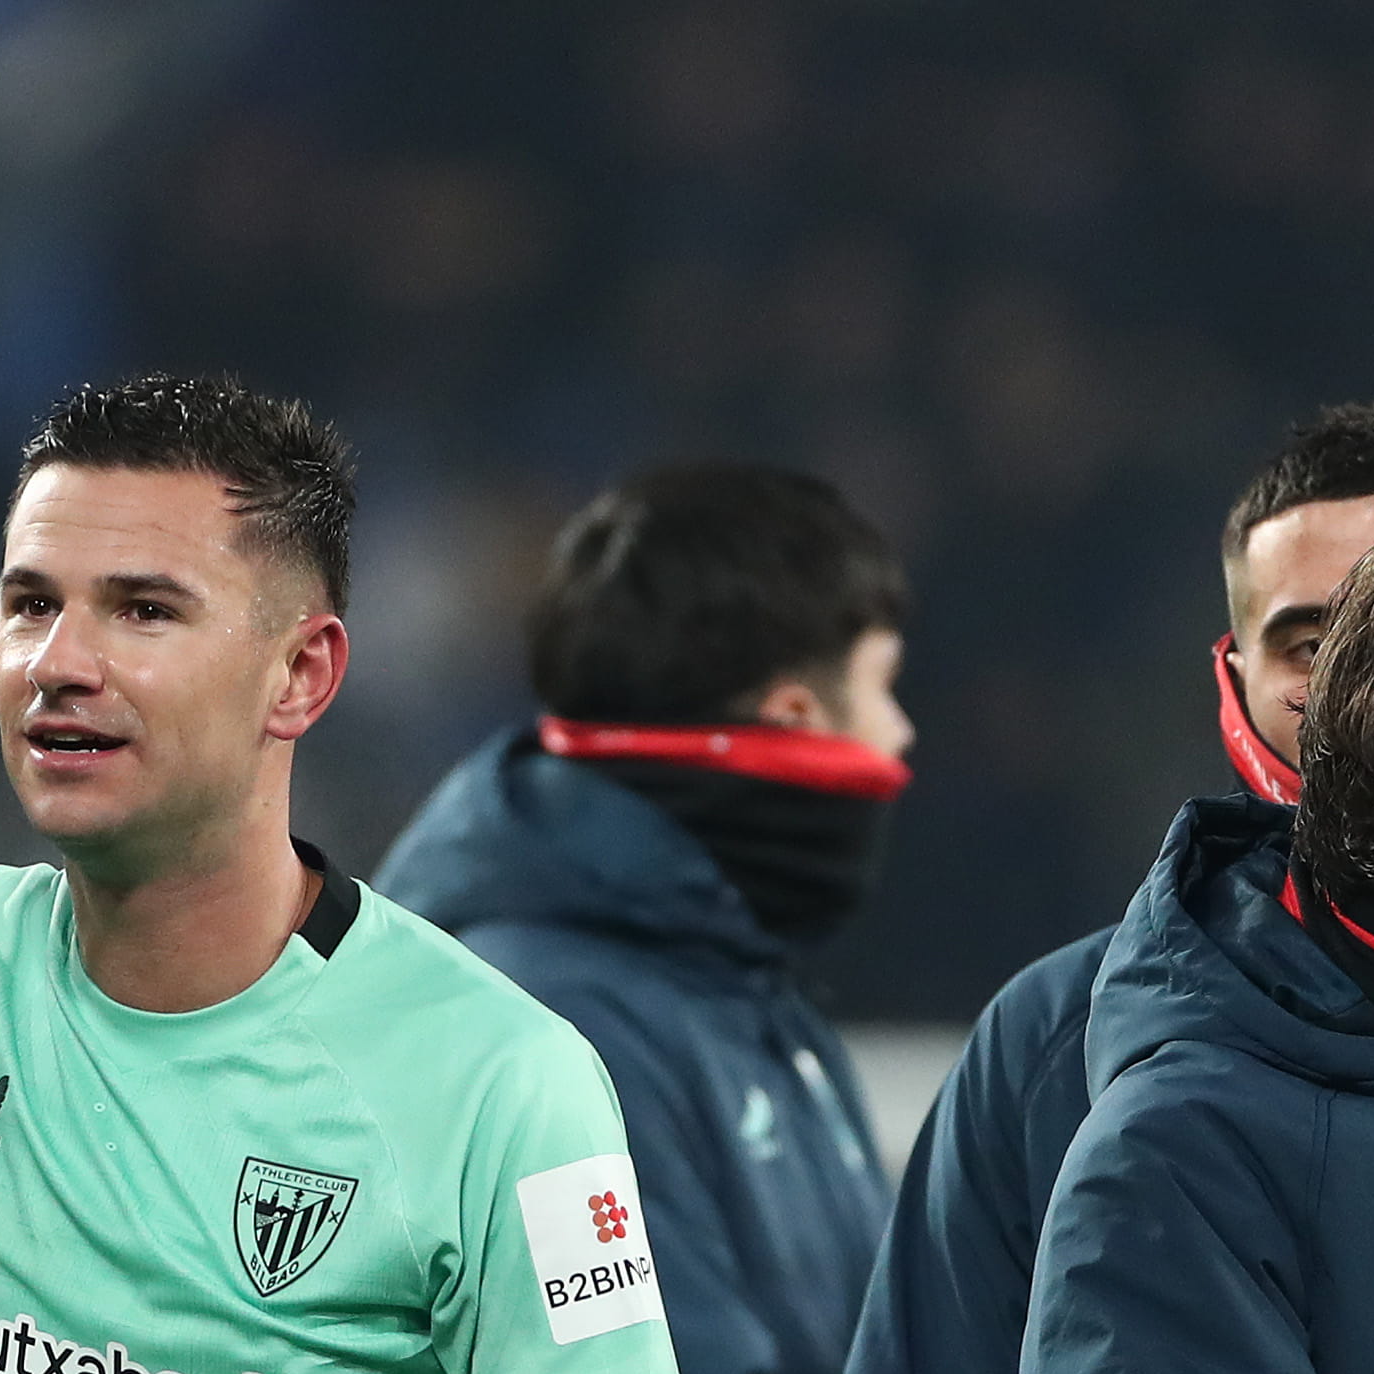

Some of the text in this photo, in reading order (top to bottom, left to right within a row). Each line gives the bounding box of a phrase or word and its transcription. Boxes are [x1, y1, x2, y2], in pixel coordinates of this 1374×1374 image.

[252, 1165, 348, 1192] ATHLETIC CLUB
[250, 1253, 299, 1290] BILBAO
